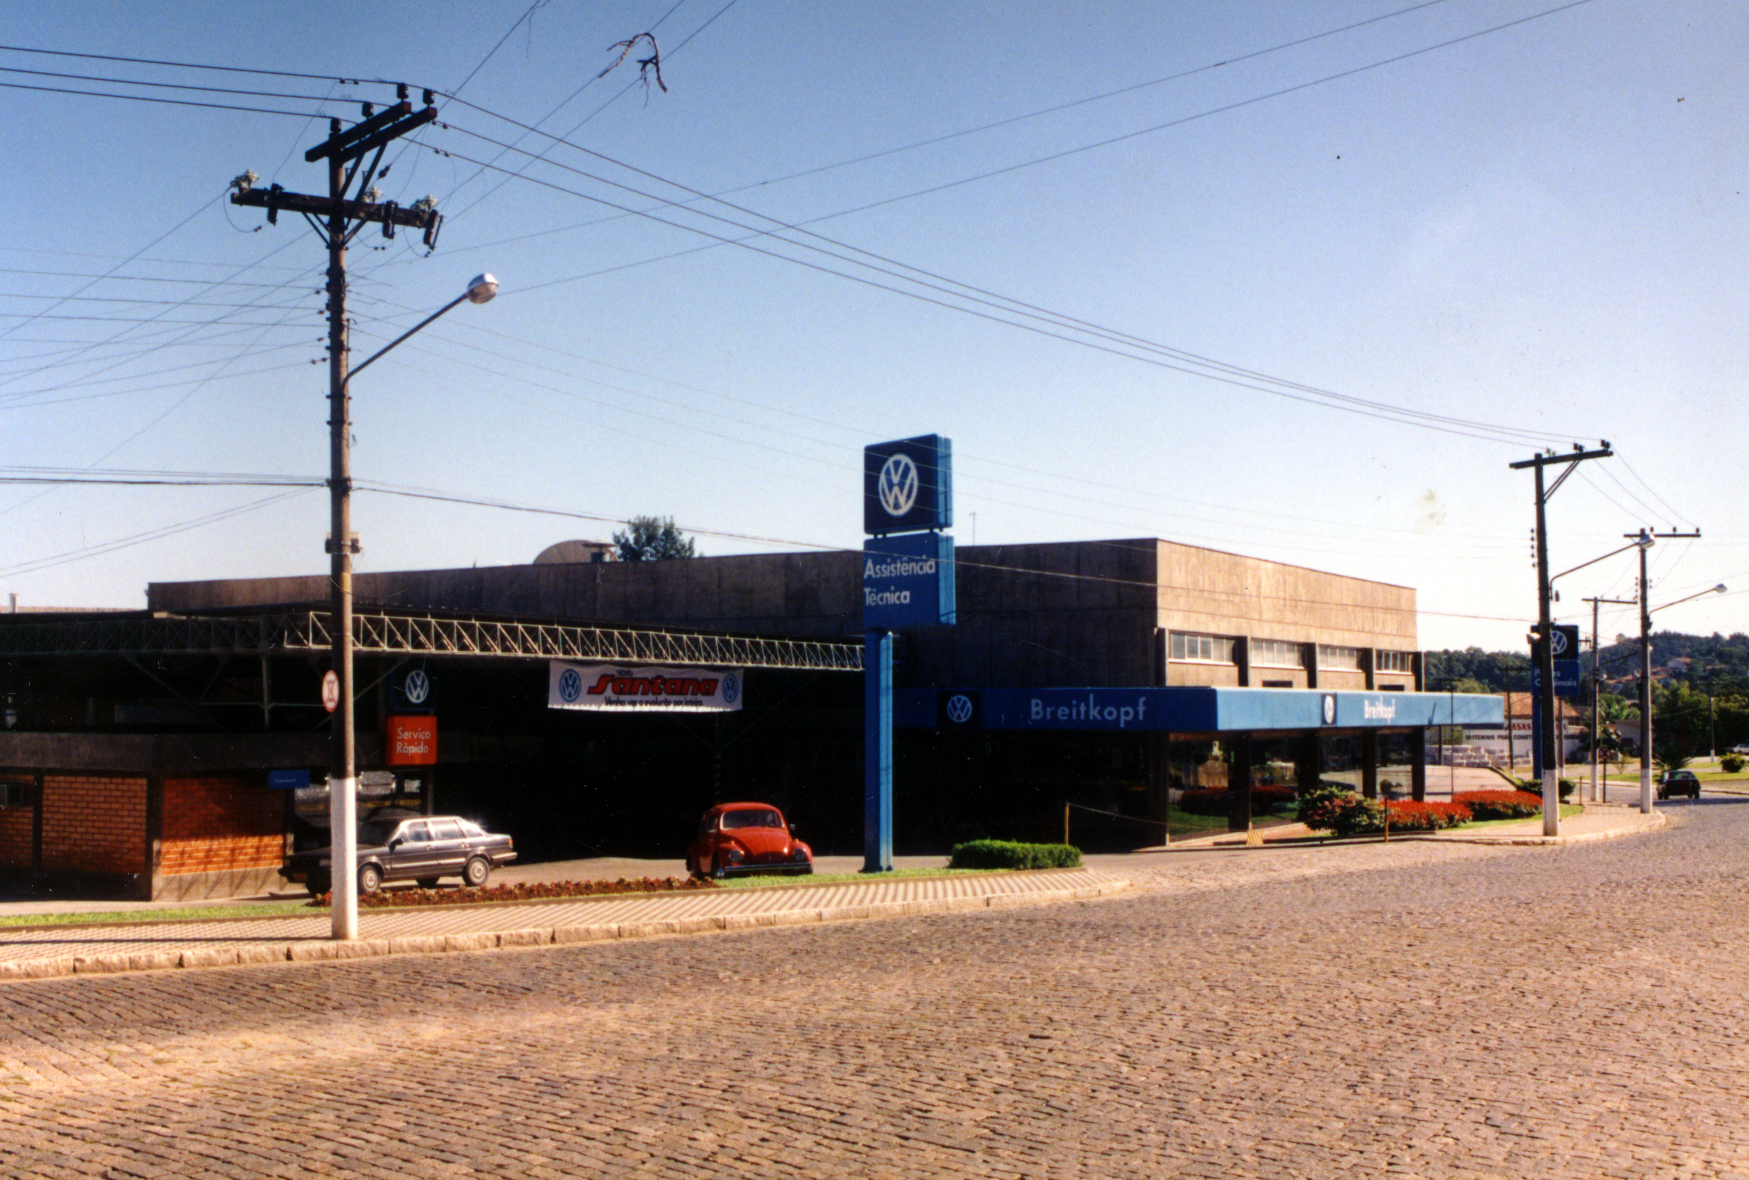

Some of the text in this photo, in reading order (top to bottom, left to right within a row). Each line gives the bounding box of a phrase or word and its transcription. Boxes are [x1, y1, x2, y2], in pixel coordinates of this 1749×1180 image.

[864, 555, 935, 578] Assistência
[864, 585, 910, 606] Técnica
[587, 674, 719, 696] Santana
[1031, 693, 1146, 728] Breitkopf
[396, 741, 429, 756] Rápido
